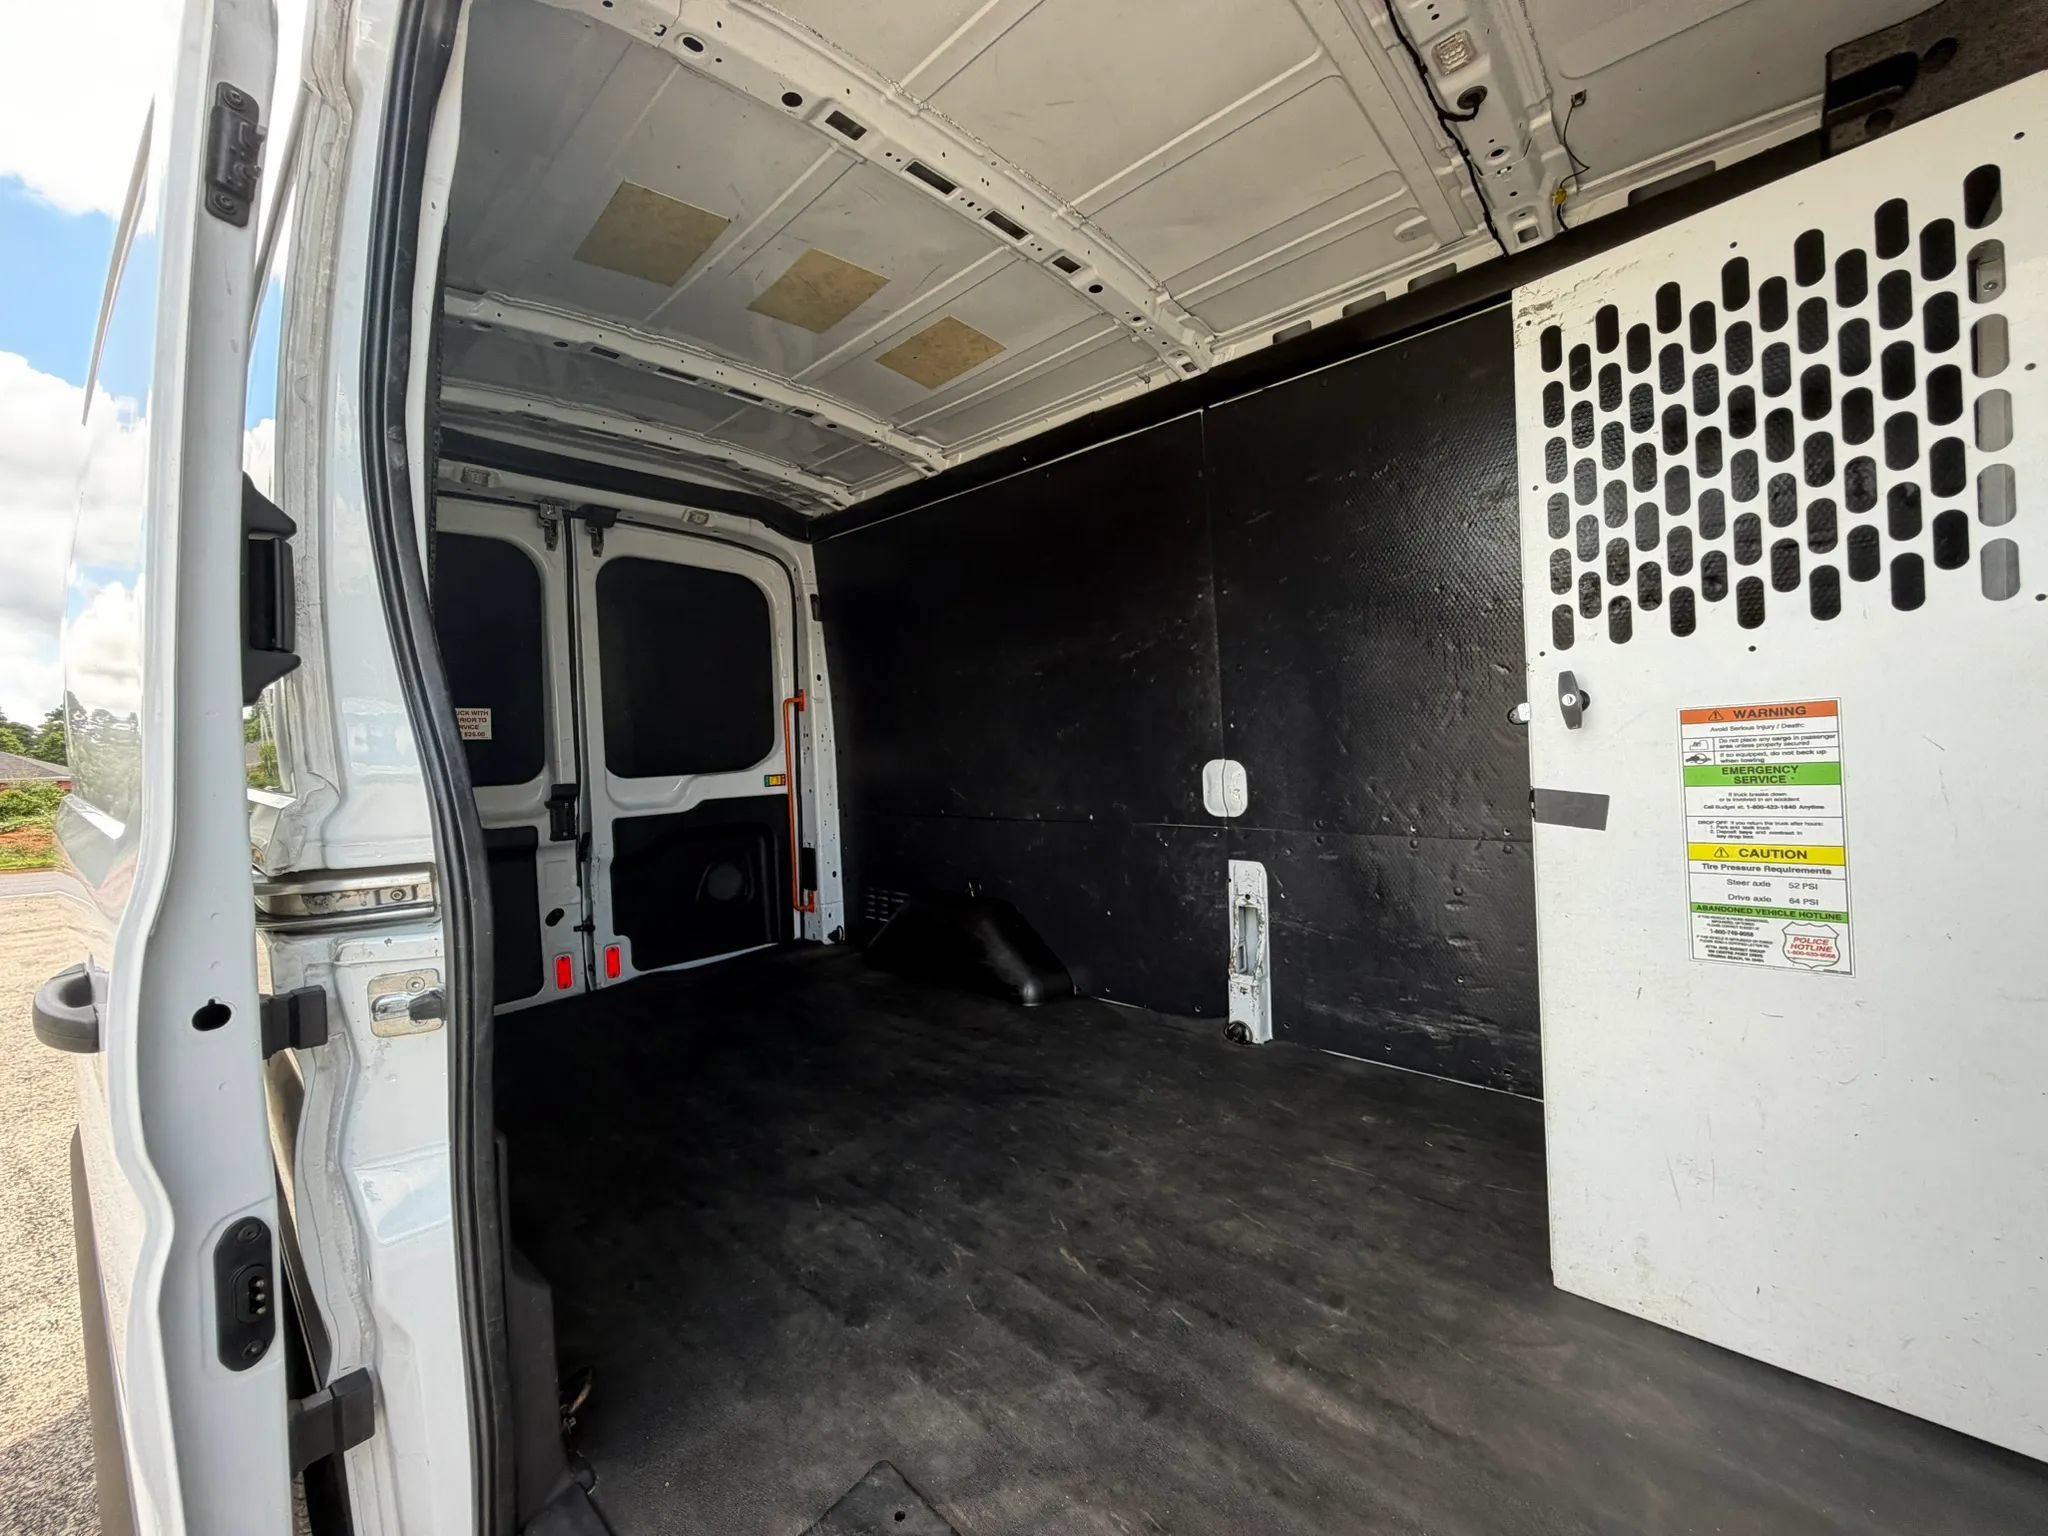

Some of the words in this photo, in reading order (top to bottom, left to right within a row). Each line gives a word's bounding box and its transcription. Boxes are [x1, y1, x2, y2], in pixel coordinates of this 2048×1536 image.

[1733, 706, 1806, 719] WARNING
[1722, 765, 1798, 775] EMERGENCY
[1734, 775, 1786, 784] SERVICE
[1739, 848, 1807, 859] CAUTION
[1721, 864, 1761, 872] Pressure
[1764, 866, 1831, 874] Requirements
[1697, 905, 1752, 914] ABANDONED
[1755, 909, 1794, 917] VEHICLE
[1796, 911, 1842, 920] HOTLINE
[1793, 937, 1829, 945] POLICE
[1791, 944, 1832, 952] HOTLINE
